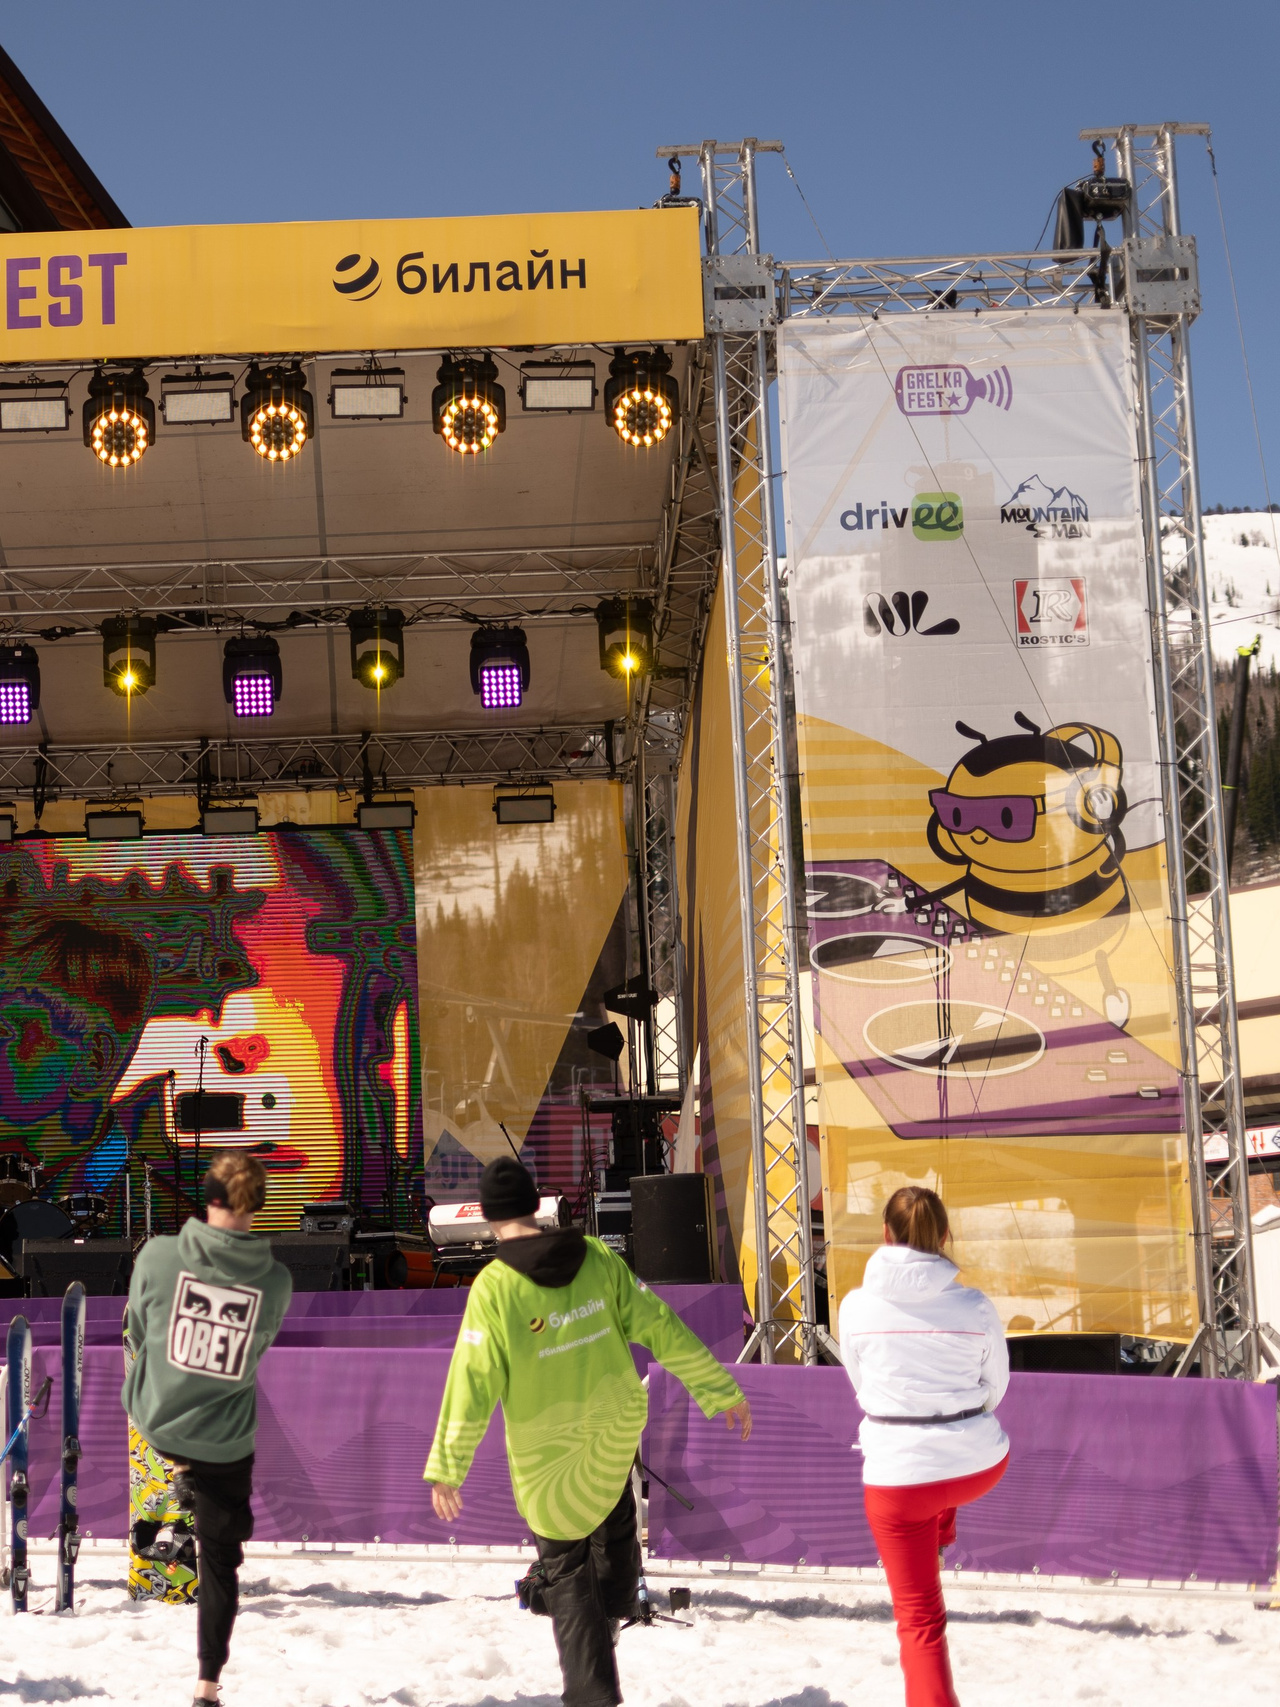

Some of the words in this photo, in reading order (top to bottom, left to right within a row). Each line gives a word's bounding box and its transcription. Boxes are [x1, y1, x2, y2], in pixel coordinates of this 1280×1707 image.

[396, 249, 587, 295] билайн
[906, 371, 963, 390] GRELKA
[907, 391, 945, 409] FEST
[839, 500, 965, 532] drivee
[1000, 503, 1090, 525] MOUNTAIN
[1051, 523, 1092, 539] MAN
[1019, 633, 1087, 646] ROSTIC'S
[548, 1298, 606, 1329] билайн
[173, 1317, 247, 1374] OBEY
[23, 1368, 31, 1399] TECNO
